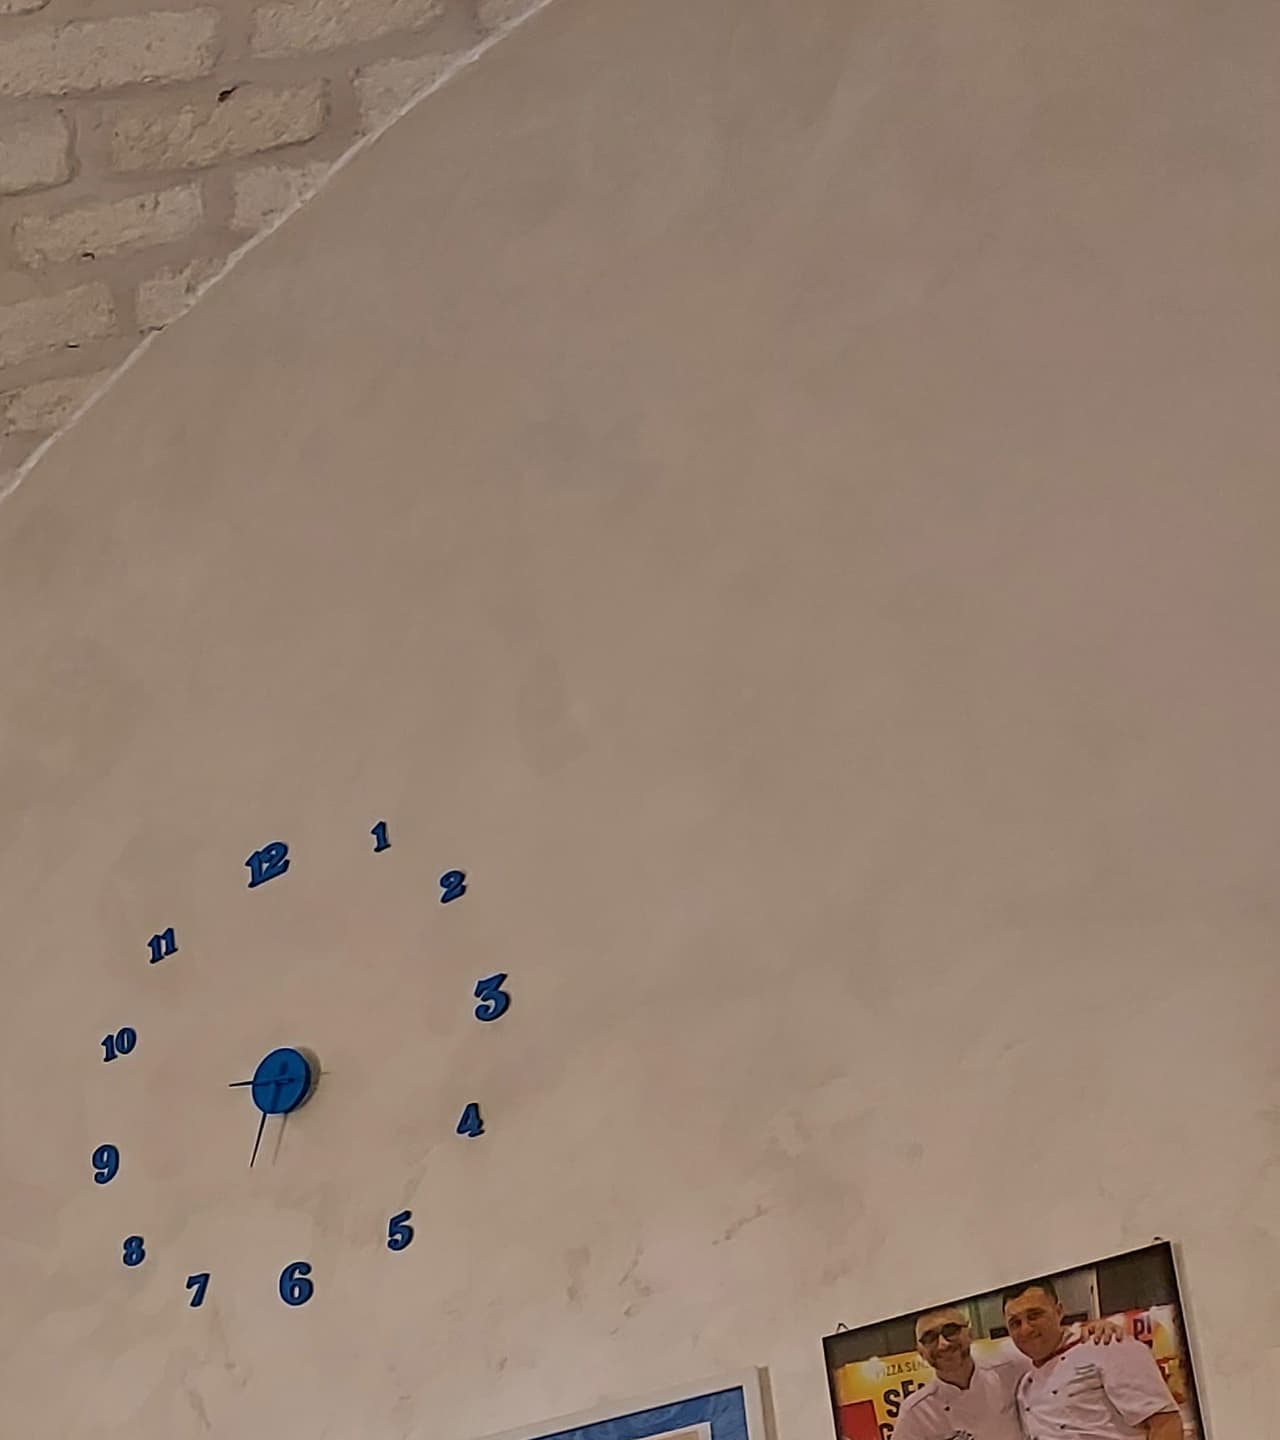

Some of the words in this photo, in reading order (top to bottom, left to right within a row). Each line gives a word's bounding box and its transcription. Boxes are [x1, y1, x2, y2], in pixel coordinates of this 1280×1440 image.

[371, 821, 391, 852] 1
[245, 840, 290, 888] 12
[440, 870, 466, 904] 2
[147, 927, 178, 964] 11
[474, 972, 511, 1022] 3
[101, 1027, 137, 1062] 10
[455, 1103, 485, 1138] 4
[92, 1144, 120, 1184] 9
[387, 1210, 414, 1251] 5
[122, 1235, 146, 1267] 8
[185, 1273, 210, 1307] 7
[279, 1261, 314, 1306] 6
